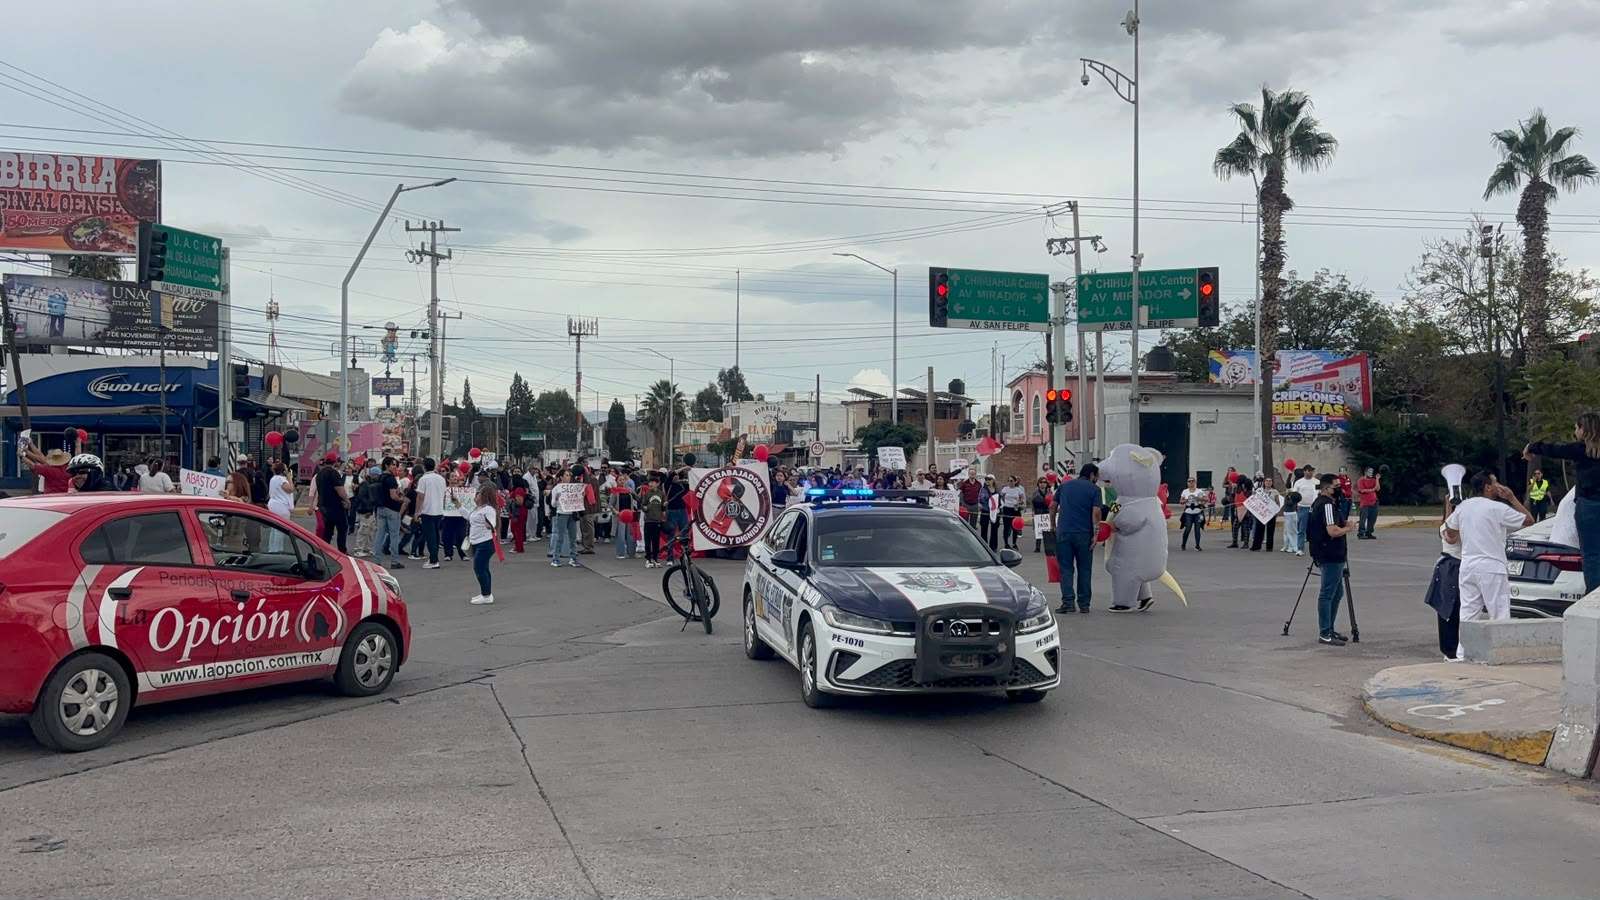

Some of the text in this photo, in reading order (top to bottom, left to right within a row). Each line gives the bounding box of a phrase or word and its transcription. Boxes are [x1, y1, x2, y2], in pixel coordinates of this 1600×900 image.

[0, 152, 117, 194] BIRRIA
[965, 275, 1046, 289] CHIHUAHUA Centro
[1160, 275, 1194, 286] Centro
[976, 290, 1026, 302] MIRADOR
[969, 320, 1030, 331] AV. SAN FELIPE
[1103, 319, 1175, 331] AV. SA ELIPE
[96, 382, 132, 392] BUD
[1272, 391, 1344, 404] CRIPCIONES
[1271, 401, 1345, 416] BIERTAS
[185, 472, 218, 490] ABASTO
[695, 469, 764, 499] BASE TRABAJADORA
[699, 522, 727, 544] UNIDAD
[735, 516, 766, 544] DIGNIDAD
[119, 598, 290, 664] La Opción
[832, 633, 864, 648] PE-1070
[160, 650, 322, 684] www.laopcion.com.mx
